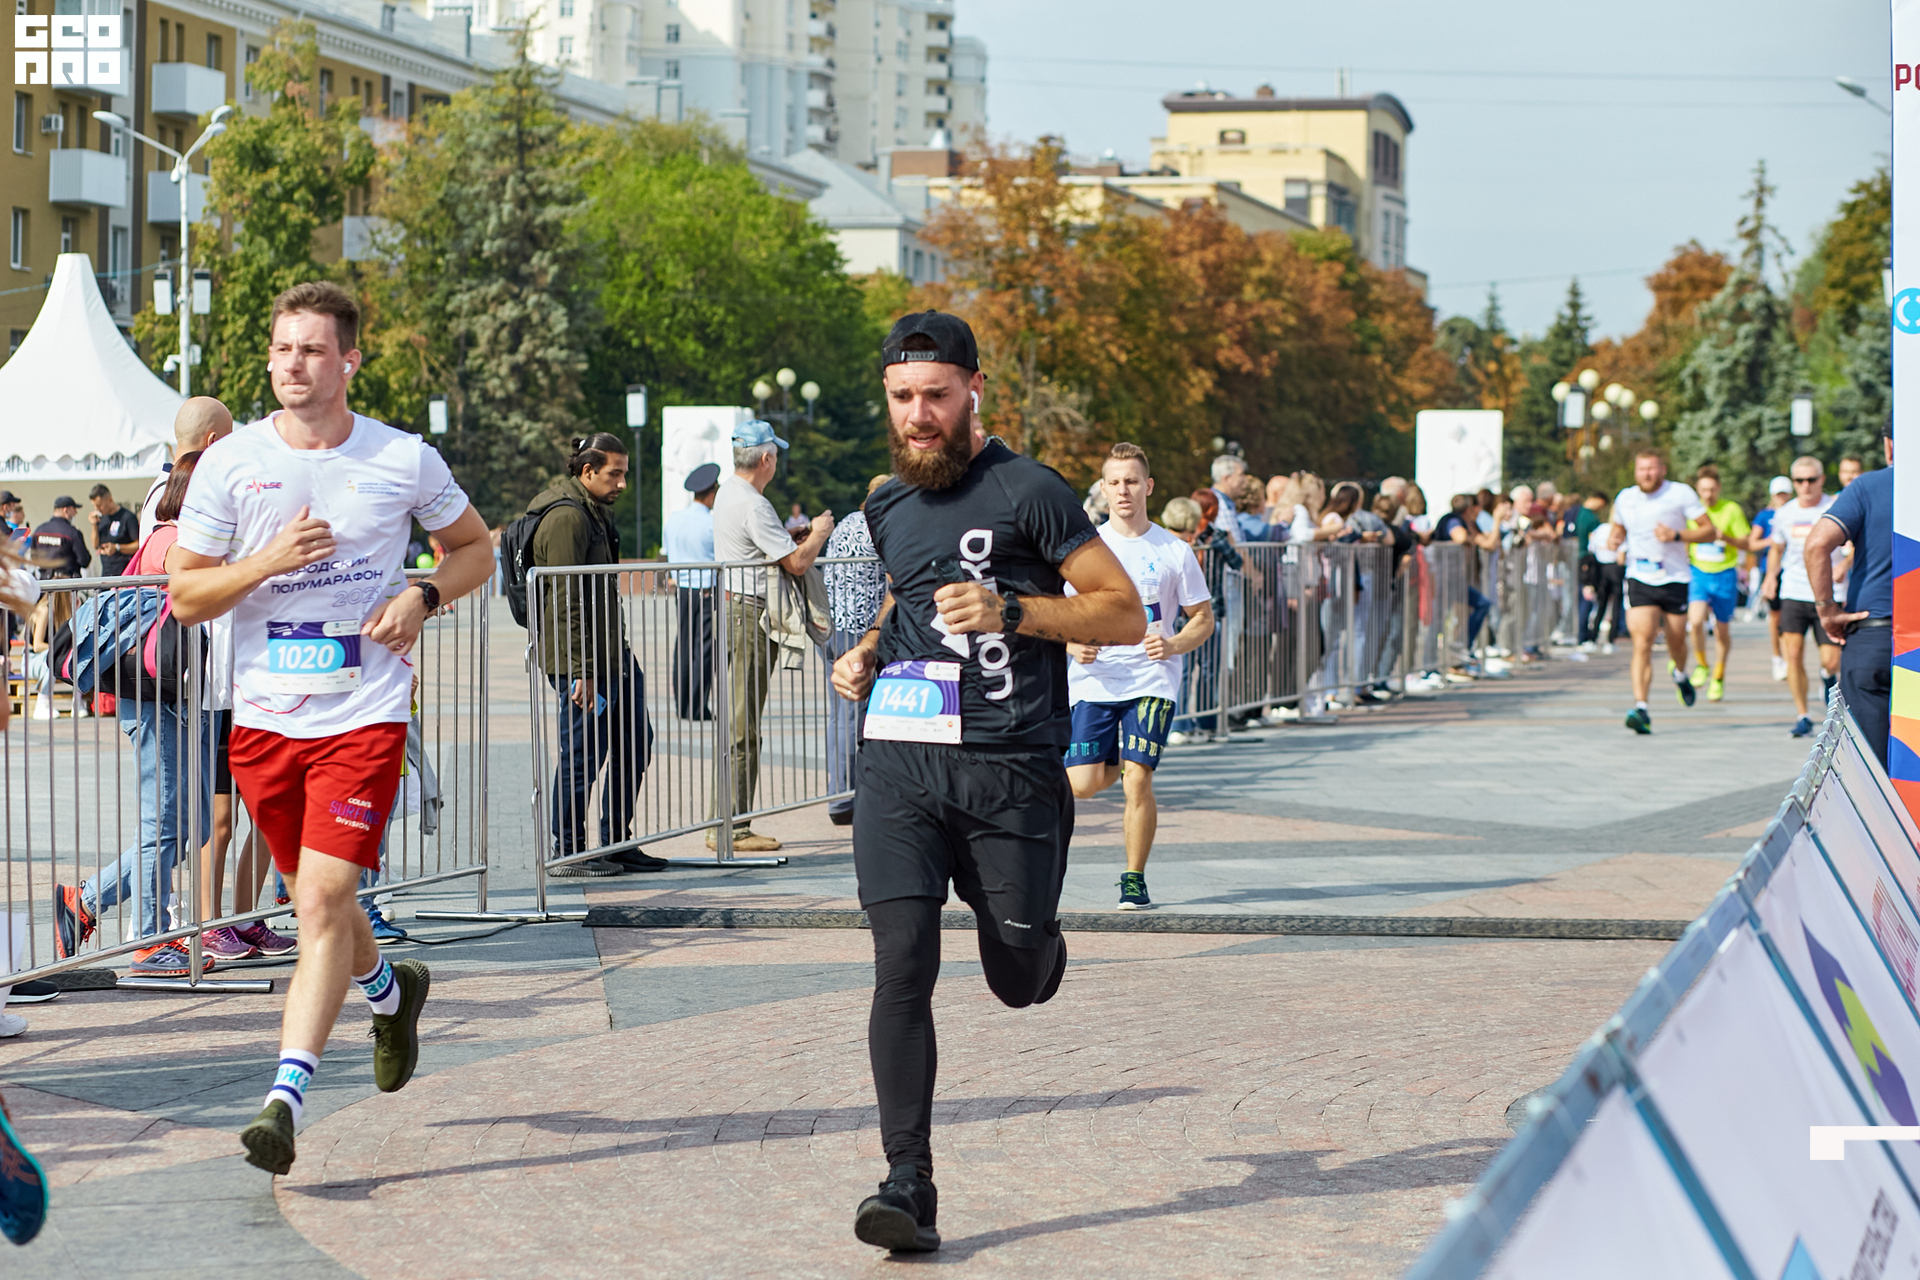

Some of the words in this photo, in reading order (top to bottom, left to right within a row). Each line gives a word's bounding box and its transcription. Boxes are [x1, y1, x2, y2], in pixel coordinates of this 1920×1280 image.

[271, 569, 383, 594] ПОЛУМАРАФОН
[277, 643, 336, 670] 1020
[878, 684, 931, 714] 1441
[329, 800, 381, 825] SURFING
[335, 816, 370, 831] DIVISION
